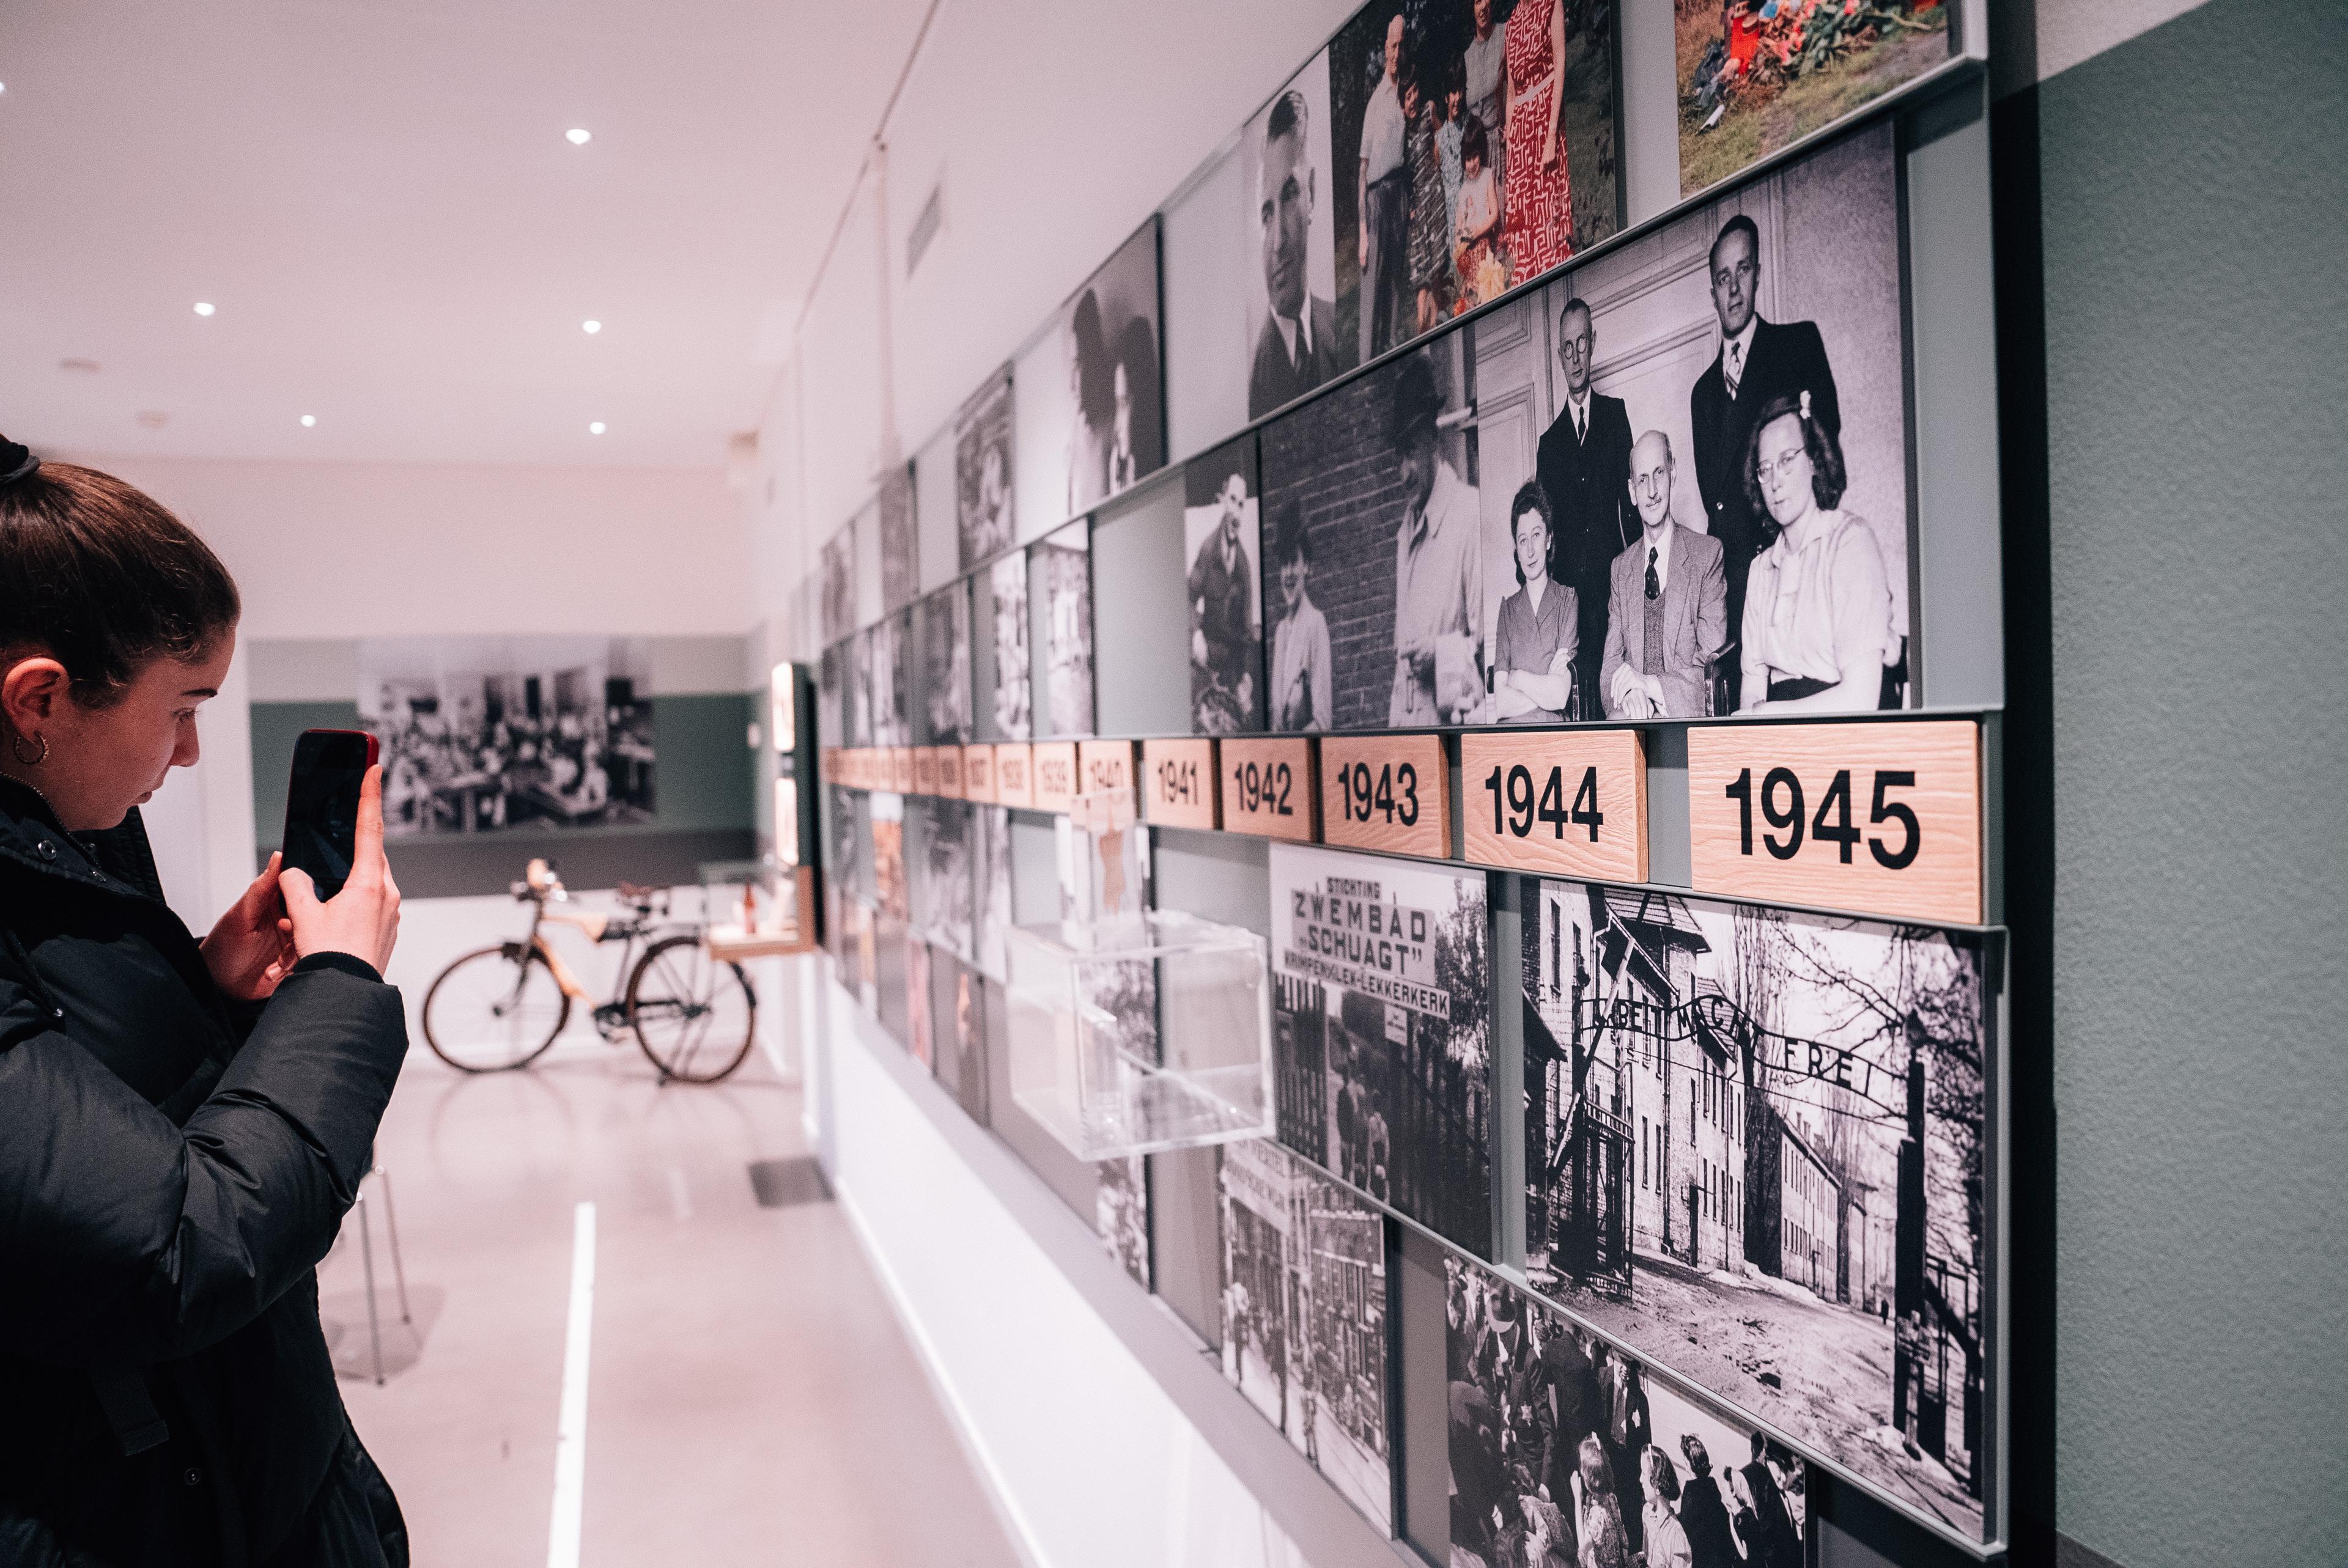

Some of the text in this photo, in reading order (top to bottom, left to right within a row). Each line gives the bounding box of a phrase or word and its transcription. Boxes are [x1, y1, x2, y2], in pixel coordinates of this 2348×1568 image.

[1157, 759, 1199, 806] 1941
[1235, 762, 1293, 816] 1942
[1338, 762, 1419, 826] 1943
[1485, 764, 1603, 842] 1944
[1726, 767, 1921, 870] 1945
[1326, 876, 1381, 900] STICHTING
[1295, 892, 1427, 943] ZWEMBAD
[1784, 1037, 1872, 1097] FREI
